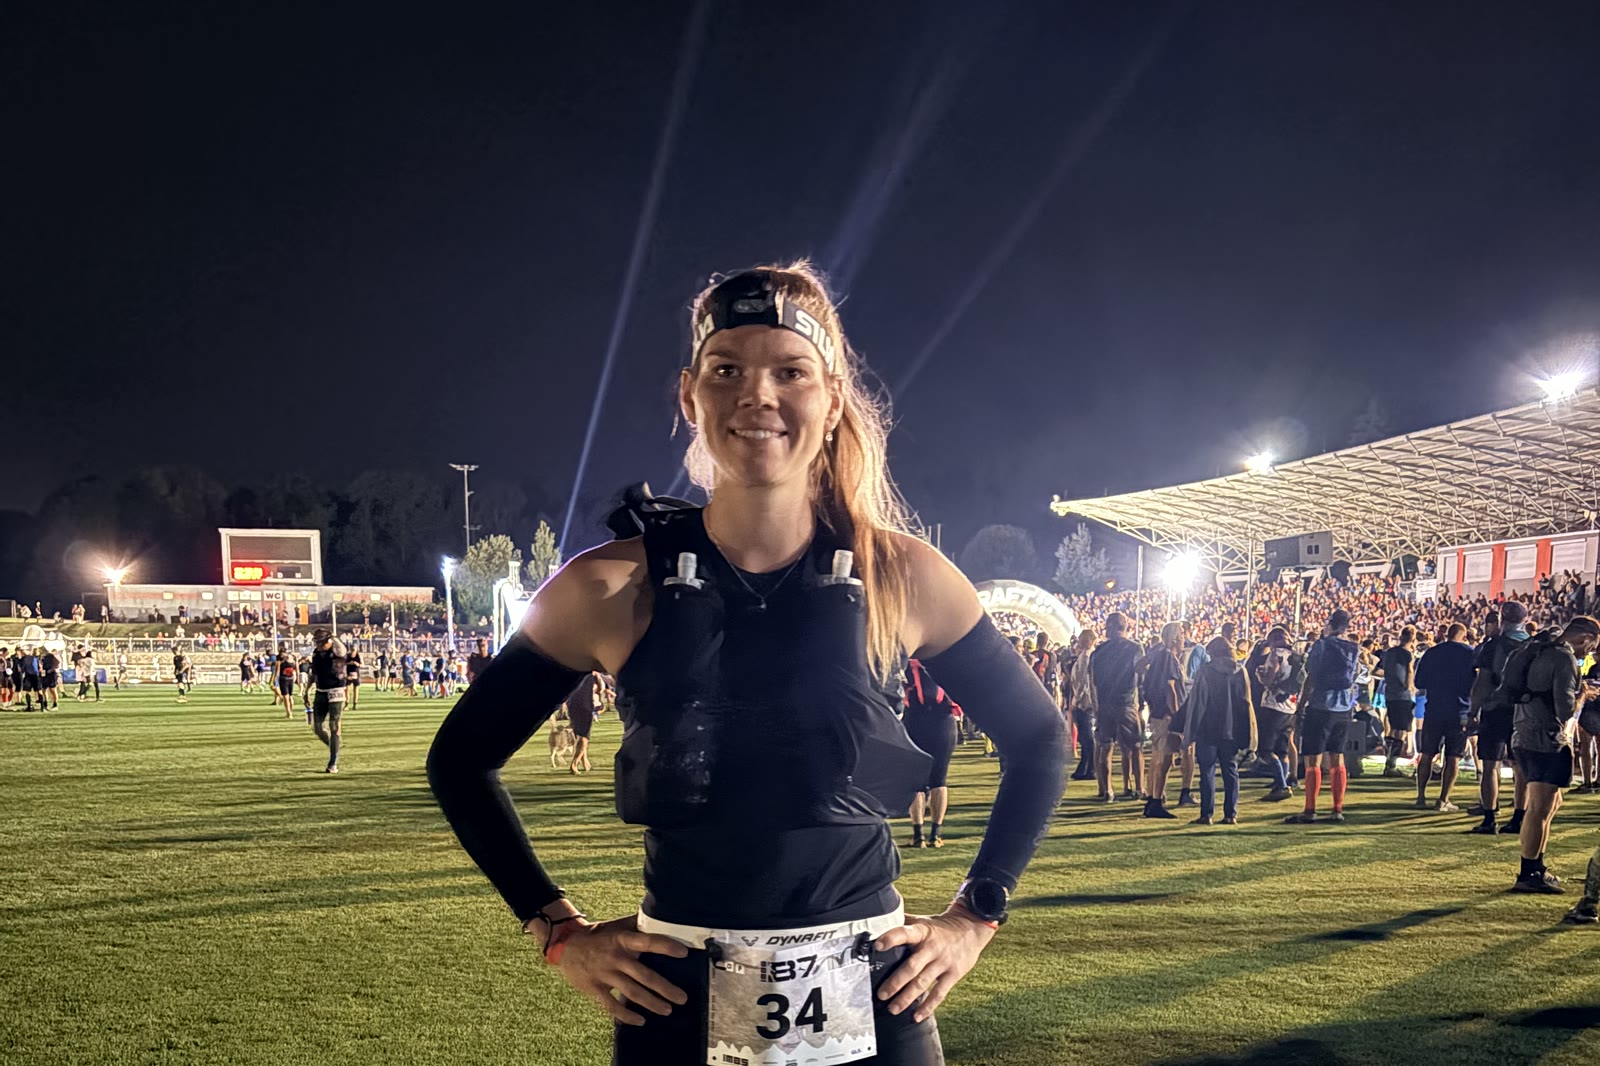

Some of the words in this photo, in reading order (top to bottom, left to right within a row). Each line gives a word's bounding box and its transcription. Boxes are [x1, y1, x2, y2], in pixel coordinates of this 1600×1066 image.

[266, 592, 281, 600] WC
[766, 930, 837, 945] DYNAFIT
[755, 986, 828, 1040] 34
